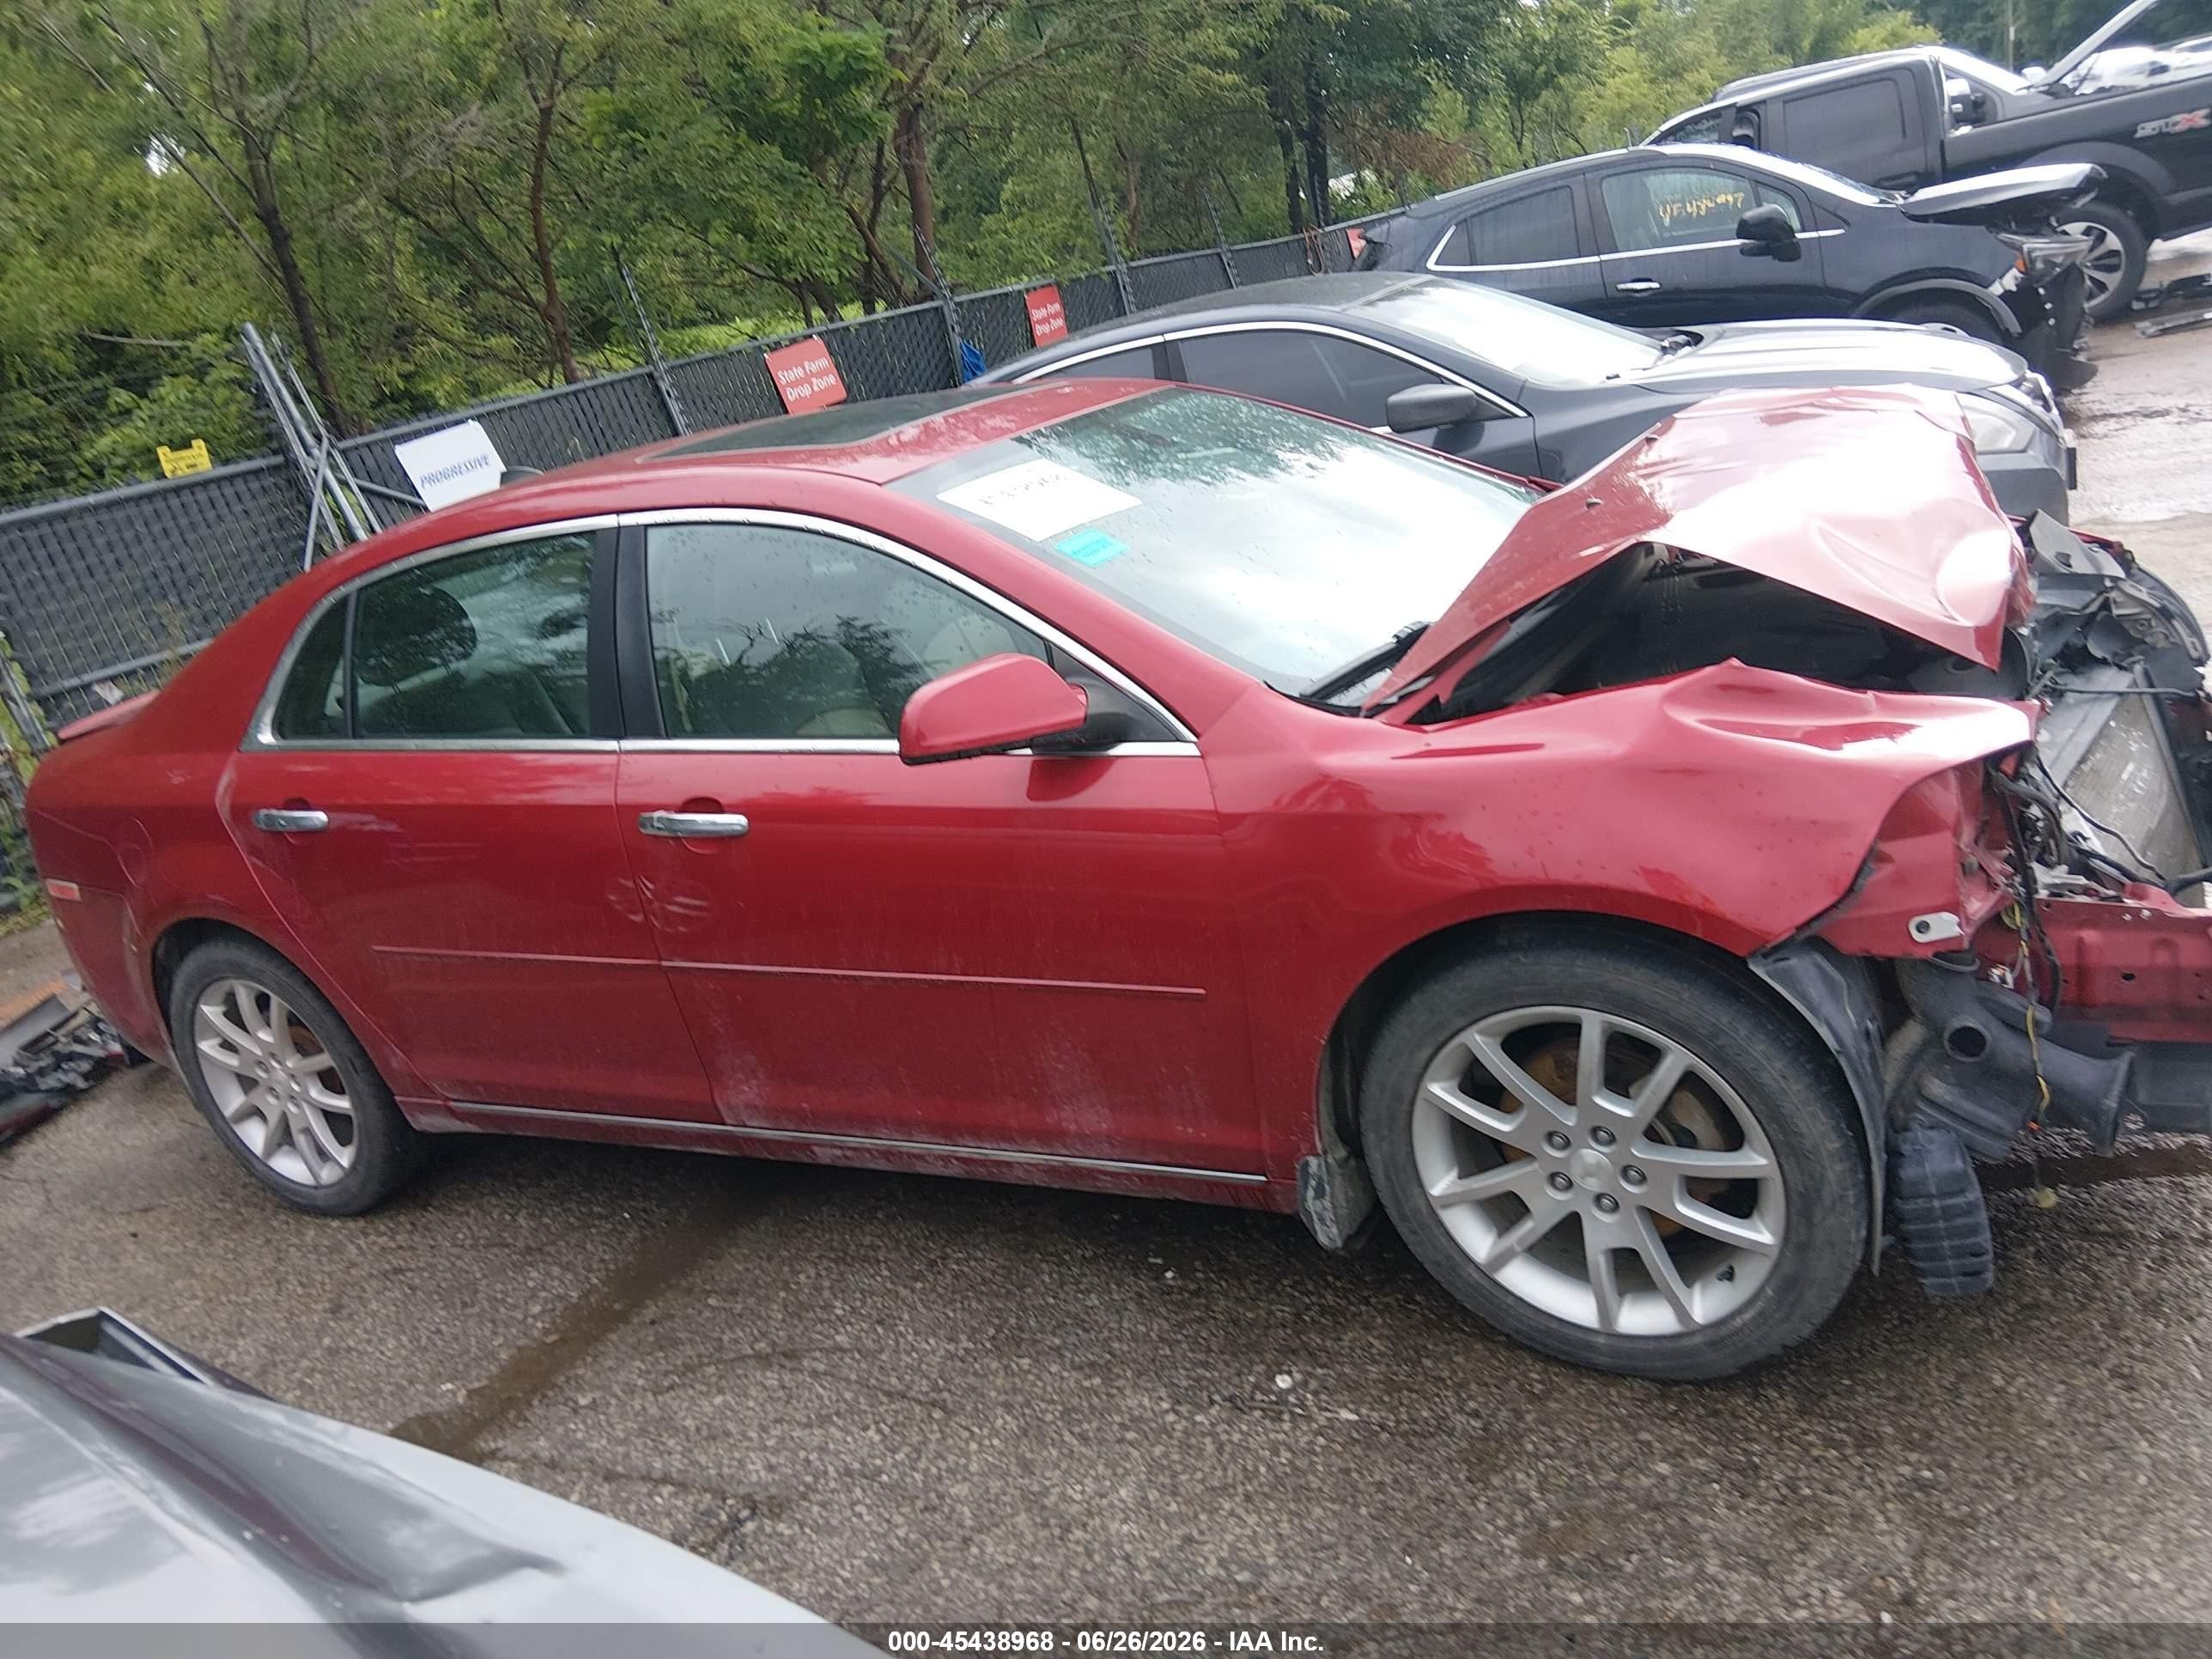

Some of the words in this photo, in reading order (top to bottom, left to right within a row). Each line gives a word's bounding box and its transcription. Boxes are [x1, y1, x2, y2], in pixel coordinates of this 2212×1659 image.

[1031, 307, 1048, 321] State
[777, 365, 805, 386] State
[804, 356, 830, 374] Farm
[786, 383, 812, 402] Drop
[811, 374, 837, 392] Zone
[419, 453, 489, 489] PROGRESSIVE
